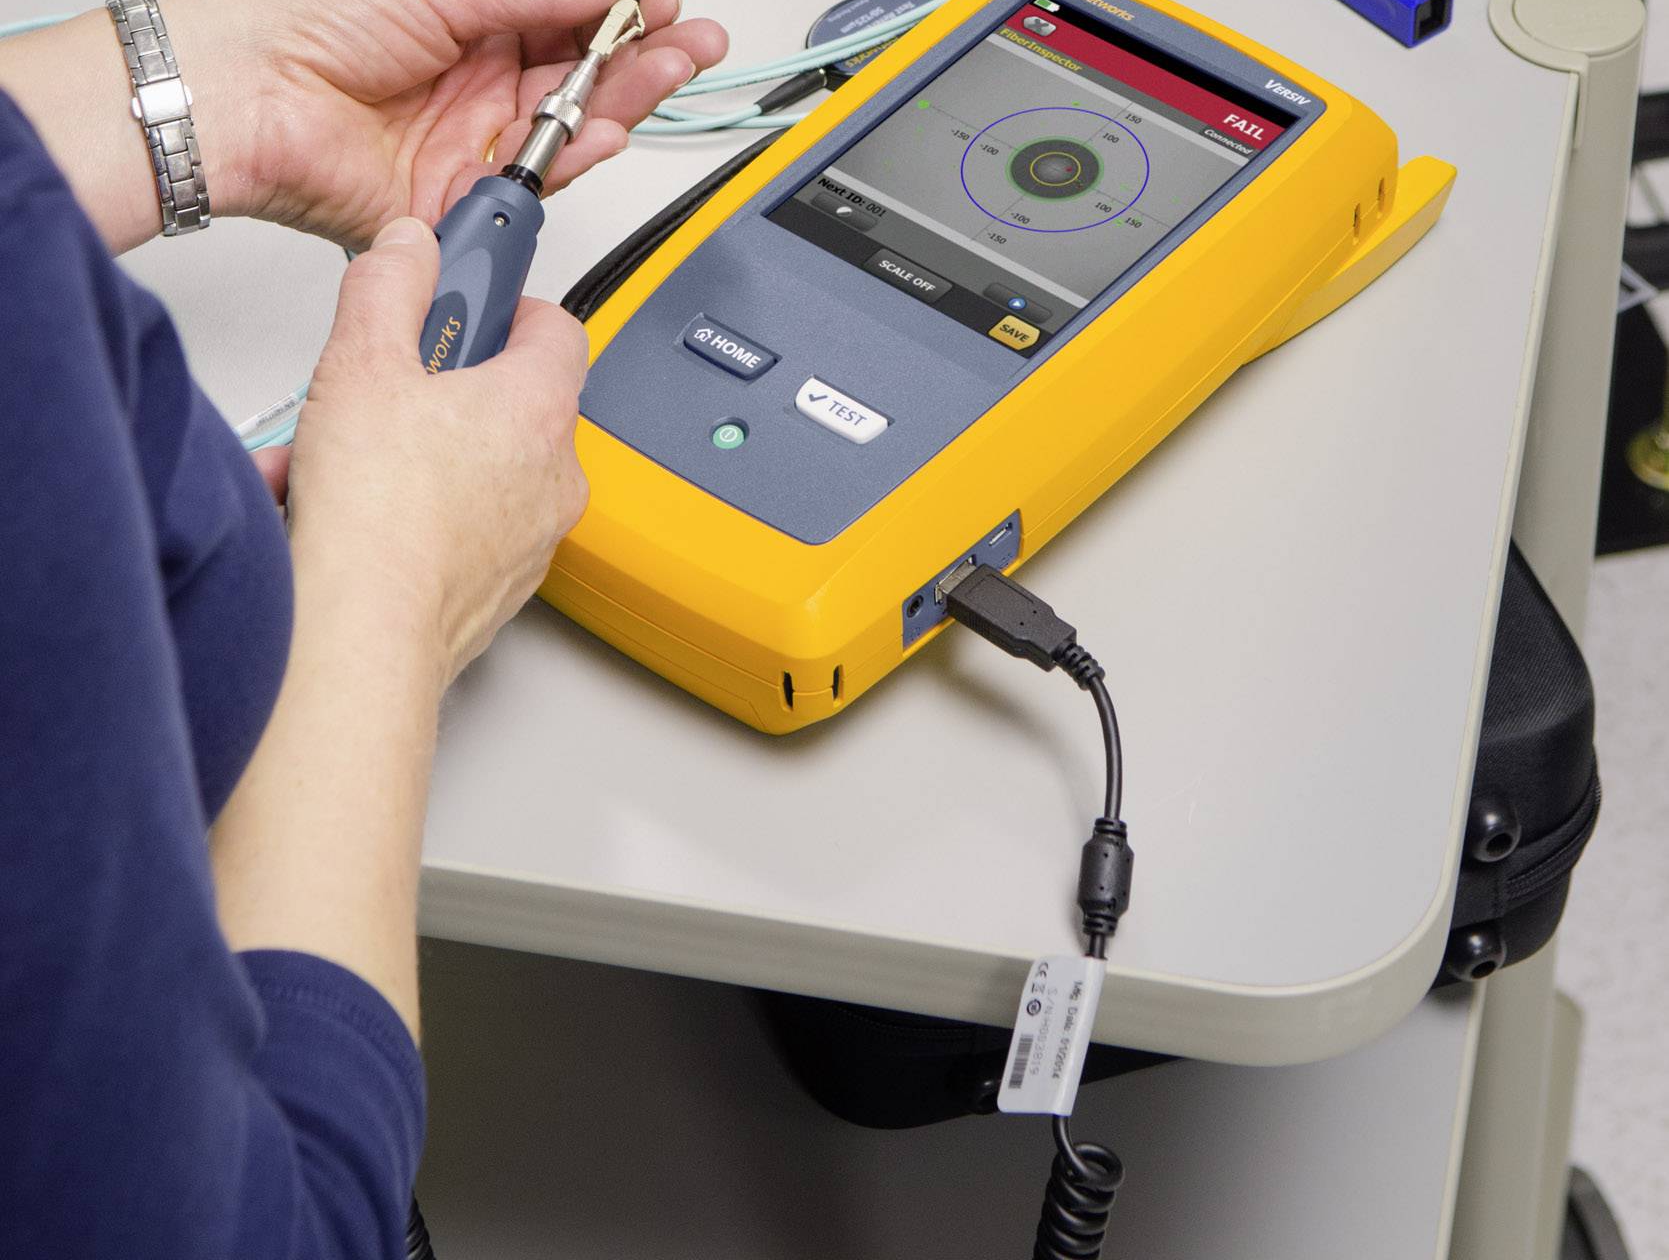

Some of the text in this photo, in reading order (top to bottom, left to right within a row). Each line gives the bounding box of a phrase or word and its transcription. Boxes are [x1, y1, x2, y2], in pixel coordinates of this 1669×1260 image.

[1000, 27, 1083, 71] FiberInspector
[1124, 113, 1142, 125] 150
[1223, 113, 1265, 141] FAIL
[951, 128, 970, 141] -150
[1102, 132, 1120, 144] 100
[1203, 128, 1252, 156] Connected
[979, 143, 999, 156] -100
[817, 177, 887, 218] Next ID: 001
[1094, 201, 1112, 213] 100
[1010, 211, 1030, 225] -100
[1124, 216, 1142, 229] 150
[987, 231, 1007, 245] -150
[878, 259, 937, 293] SCALE OFF
[999, 323, 1030, 343] SAVE
[709, 335, 762, 369] HOME
[828, 400, 867, 427] TEST
